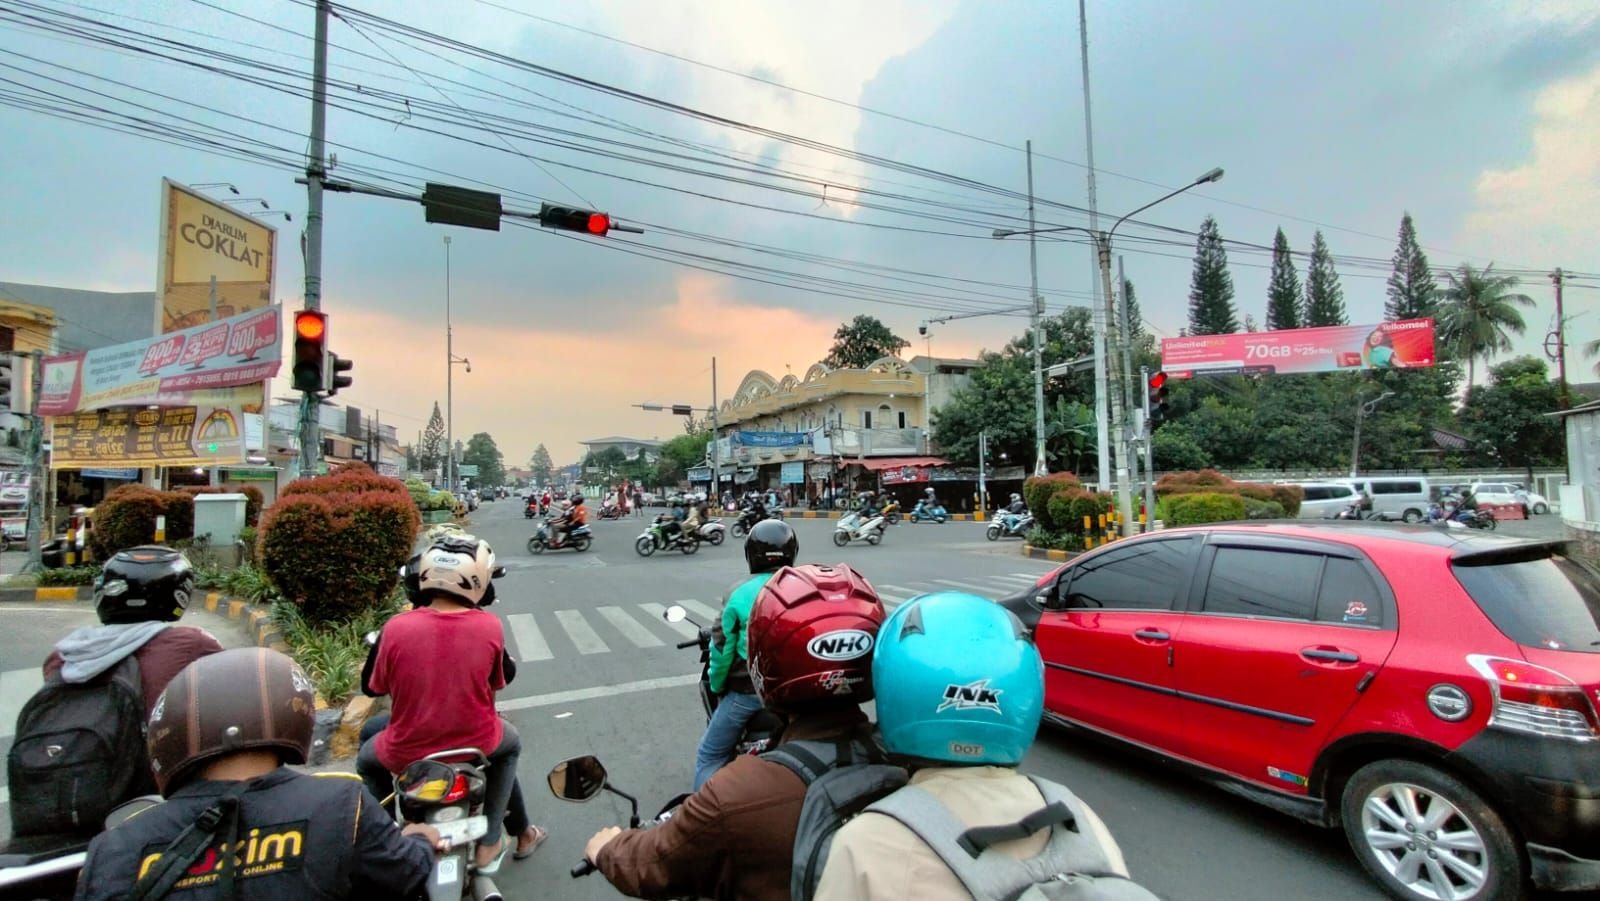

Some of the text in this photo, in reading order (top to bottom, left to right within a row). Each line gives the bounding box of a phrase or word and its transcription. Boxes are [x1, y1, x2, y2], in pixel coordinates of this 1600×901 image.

[201, 213, 248, 243] DJARUM
[180, 223, 264, 269] COKLAT
[1381, 320, 1429, 331] Telkomsel
[231, 325, 255, 354] 900
[148, 339, 172, 361] 900
[1244, 344, 1292, 359] 70GB
[818, 634, 865, 655] NHK
[945, 685, 1000, 704] INK
[953, 743, 981, 755] DOT
[243, 861, 284, 876] ONLINE
